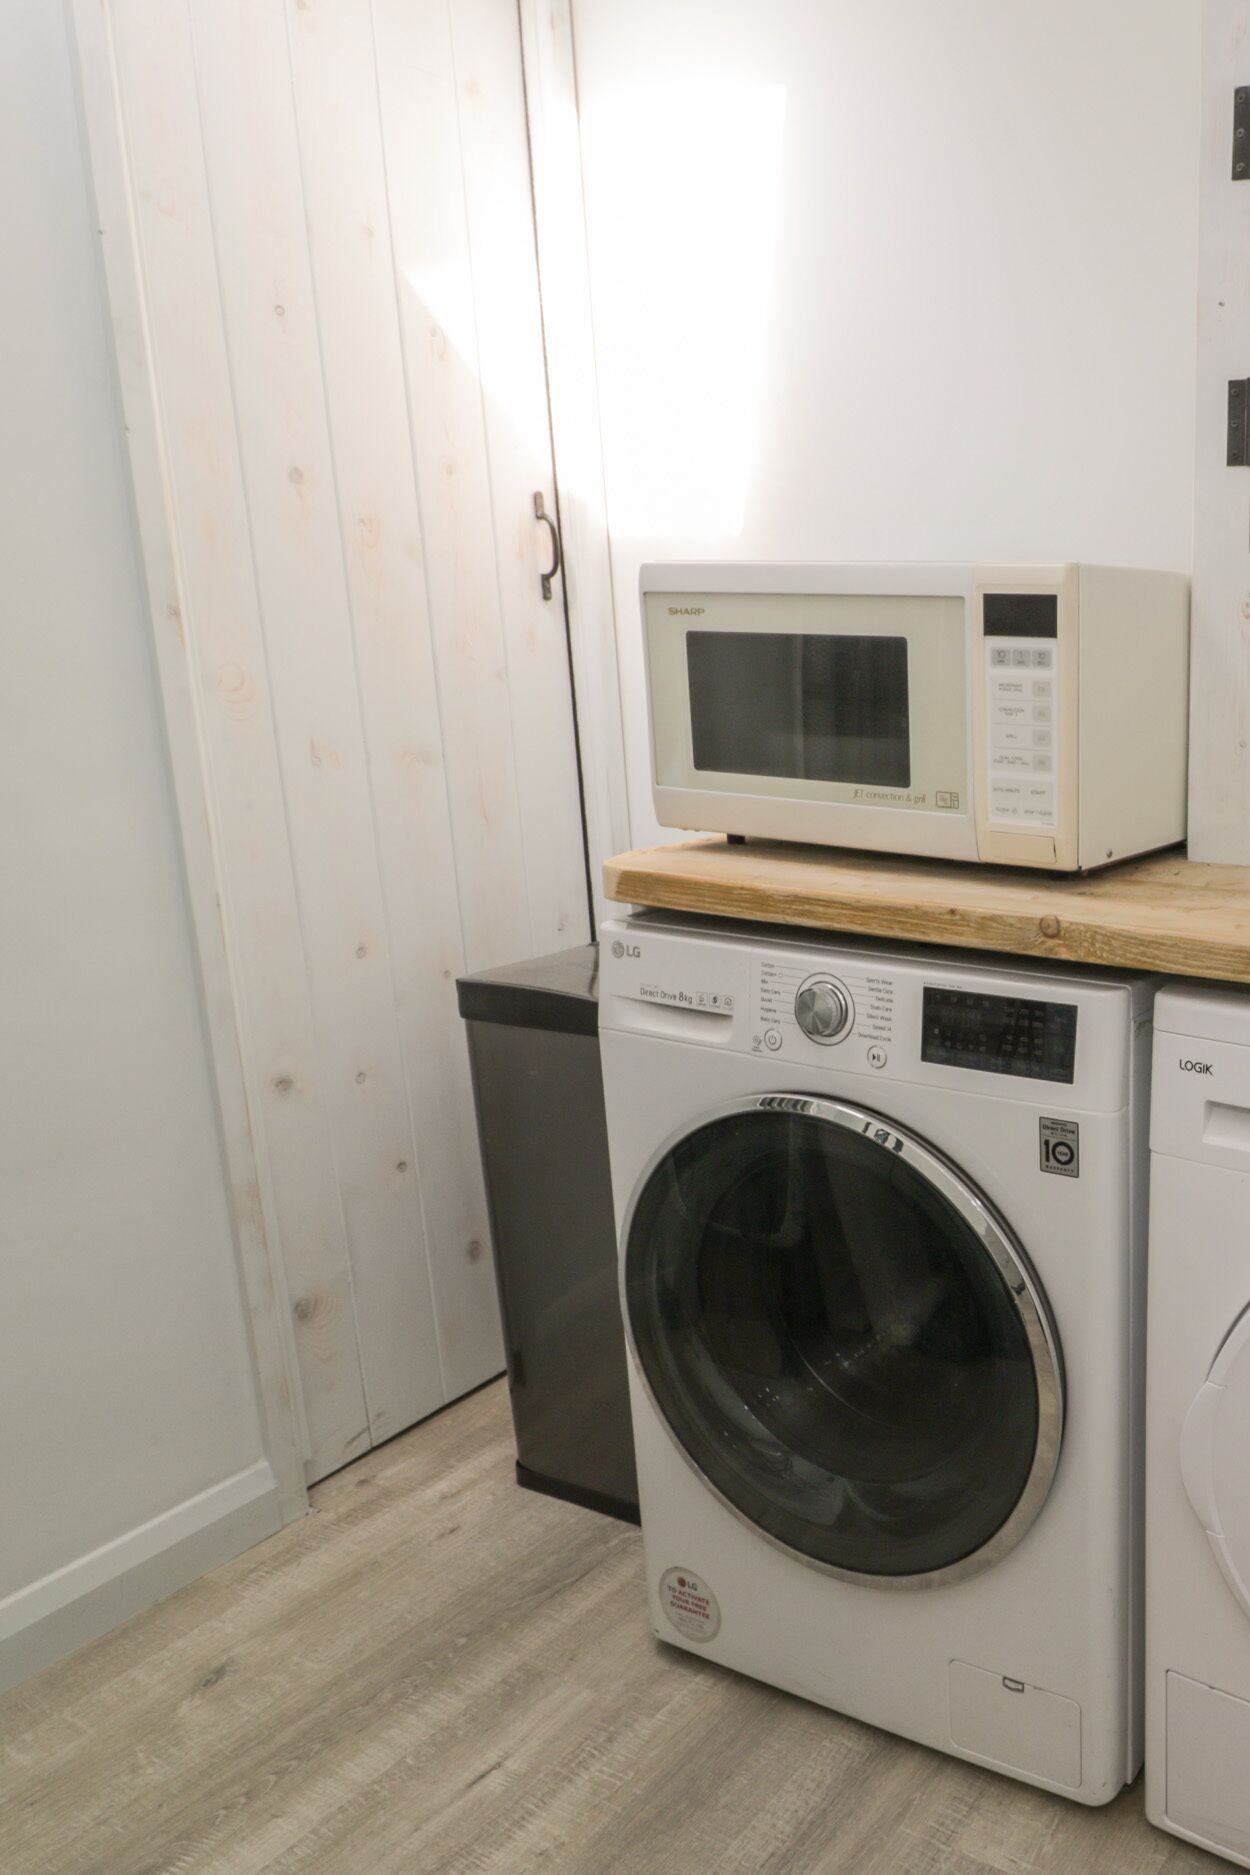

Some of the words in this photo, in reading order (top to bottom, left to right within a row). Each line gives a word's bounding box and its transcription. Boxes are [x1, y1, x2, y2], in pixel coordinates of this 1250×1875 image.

[668, 607, 705, 616] SHARP
[864, 790, 905, 802] convection
[626, 945, 641, 959] LG
[640, 987, 659, 998] Direct
[660, 990, 678, 1001] Drive
[678, 992, 693, 1005] 8kg
[1179, 1059, 1215, 1076] LOGIK
[1042, 1123, 1059, 1132] Direct
[1060, 1127, 1076, 1135] Drive
[1043, 1139, 1075, 1166] 10
[687, 1580, 698, 1591] LG
[667, 1584, 678, 1594] TO
[678, 1590, 710, 1606] ACTIVATE
[672, 1594, 690, 1605] YOUR
[690, 1600, 706, 1612] FREE
[670, 1600, 711, 1620] GUARANTEE
